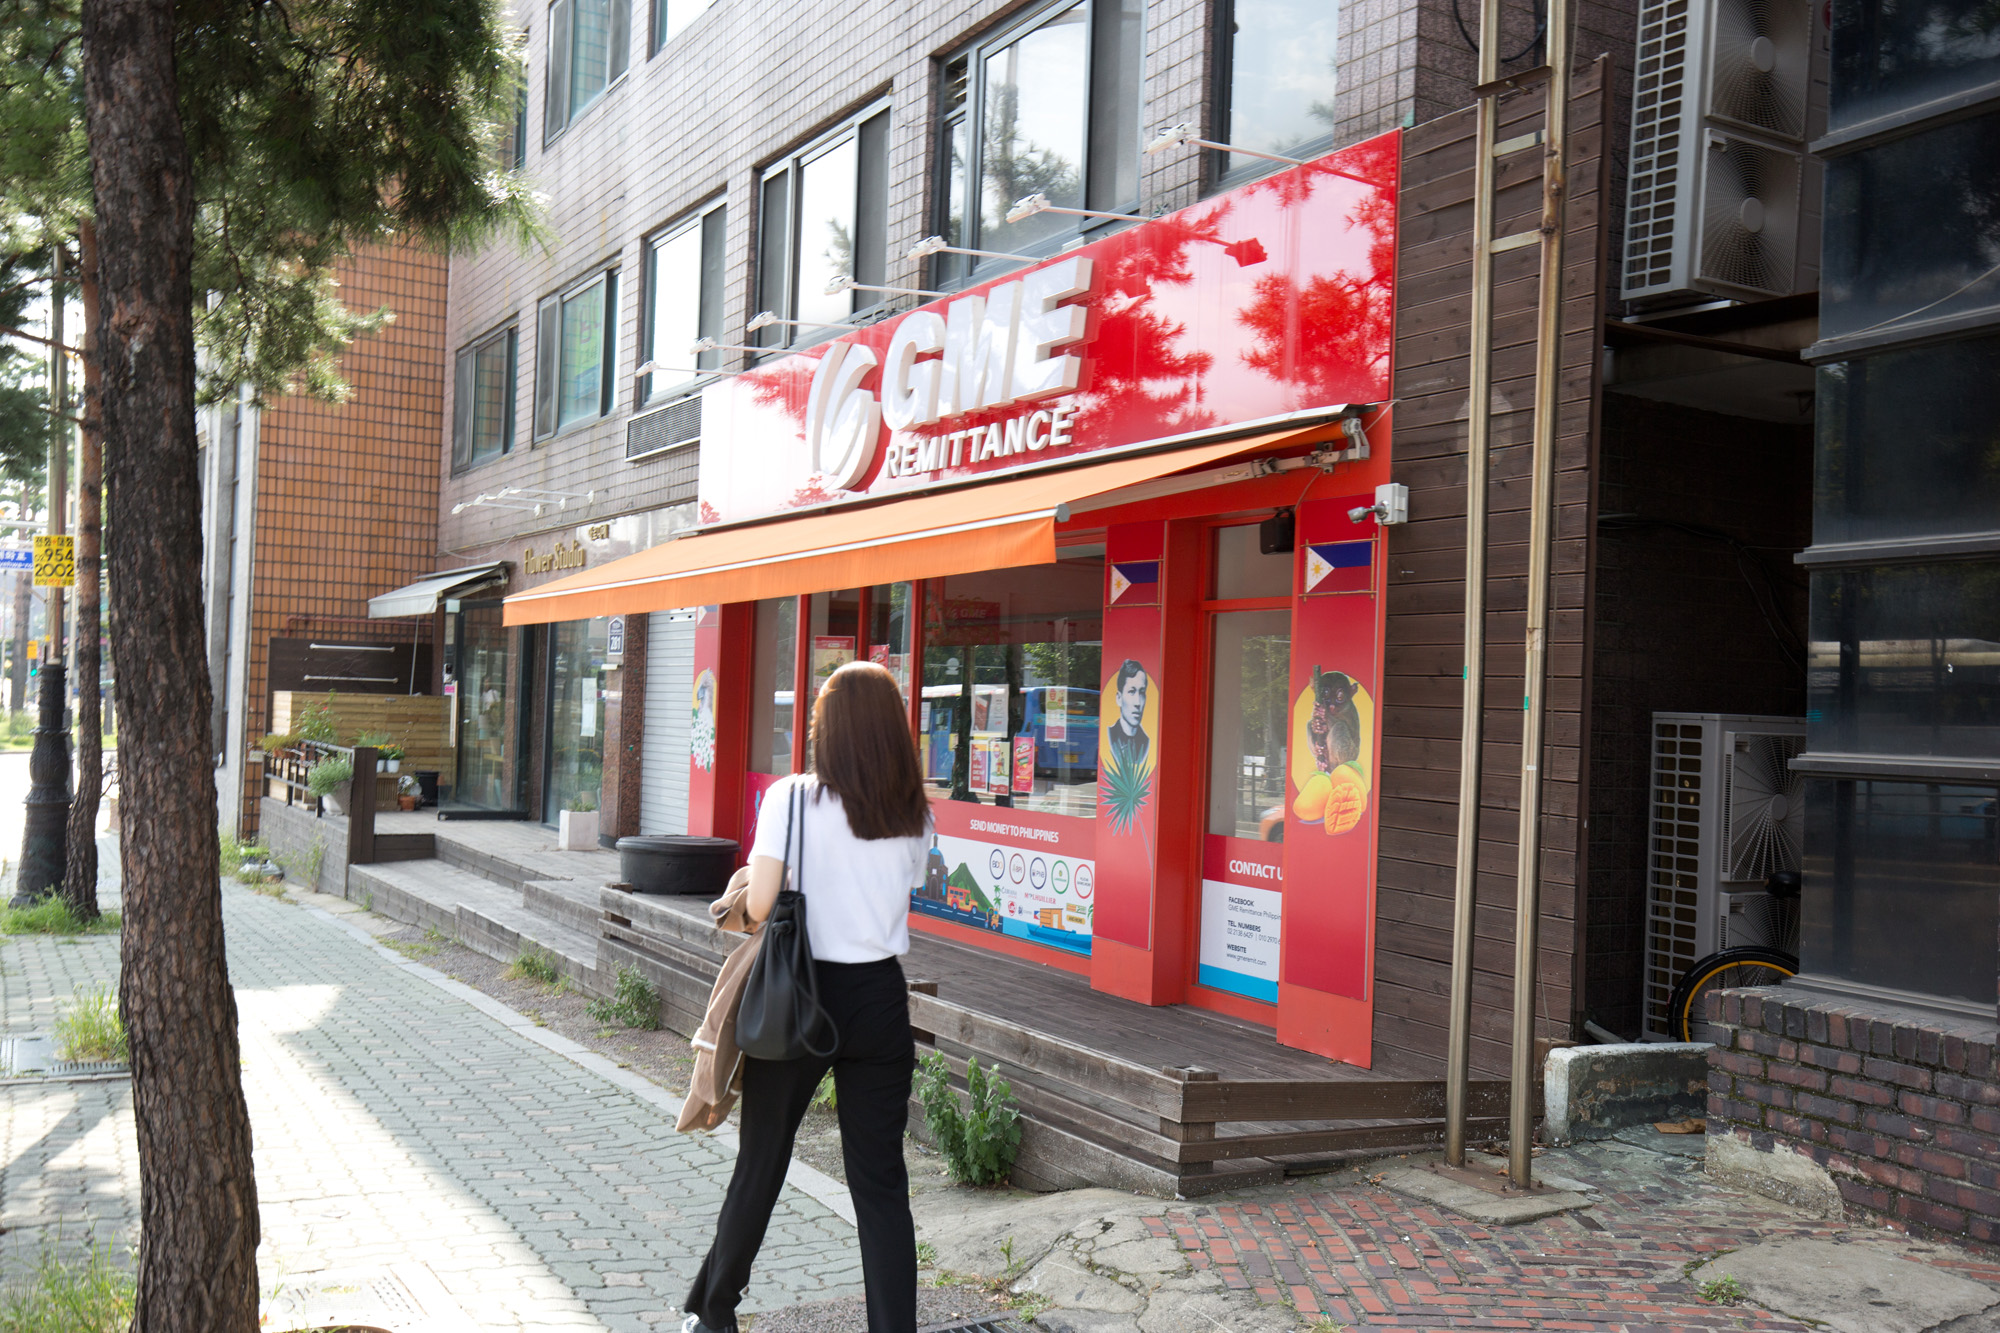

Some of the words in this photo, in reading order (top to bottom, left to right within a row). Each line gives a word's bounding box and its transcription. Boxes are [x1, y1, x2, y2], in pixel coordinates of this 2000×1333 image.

[880, 256, 1094, 432] GME
[885, 404, 1080, 479] REMITTANCE
[44, 548, 74, 562] 954
[524, 548, 553, 574] Flower
[554, 540, 585, 570] Studio
[35, 563, 74, 577] 2002
[970, 819, 986, 832] SEND
[987, 821, 1010, 835] MONEY
[1010, 825, 1019, 837] TO
[1019, 826, 1059, 843] PHILIPPINES
[1229, 860, 1276, 879] CONTACT
[1277, 867, 1283, 881] U
[1228, 896, 1255, 907] FACEBOOK
[1228, 904, 1239, 912] GME
[1240, 906, 1262, 917] Remittance
[1238, 922, 1261, 932] NUMBERS
[1226, 943, 1247, 954] WEBSITE
[1226, 954, 1267, 965] www.gmeremit.com
